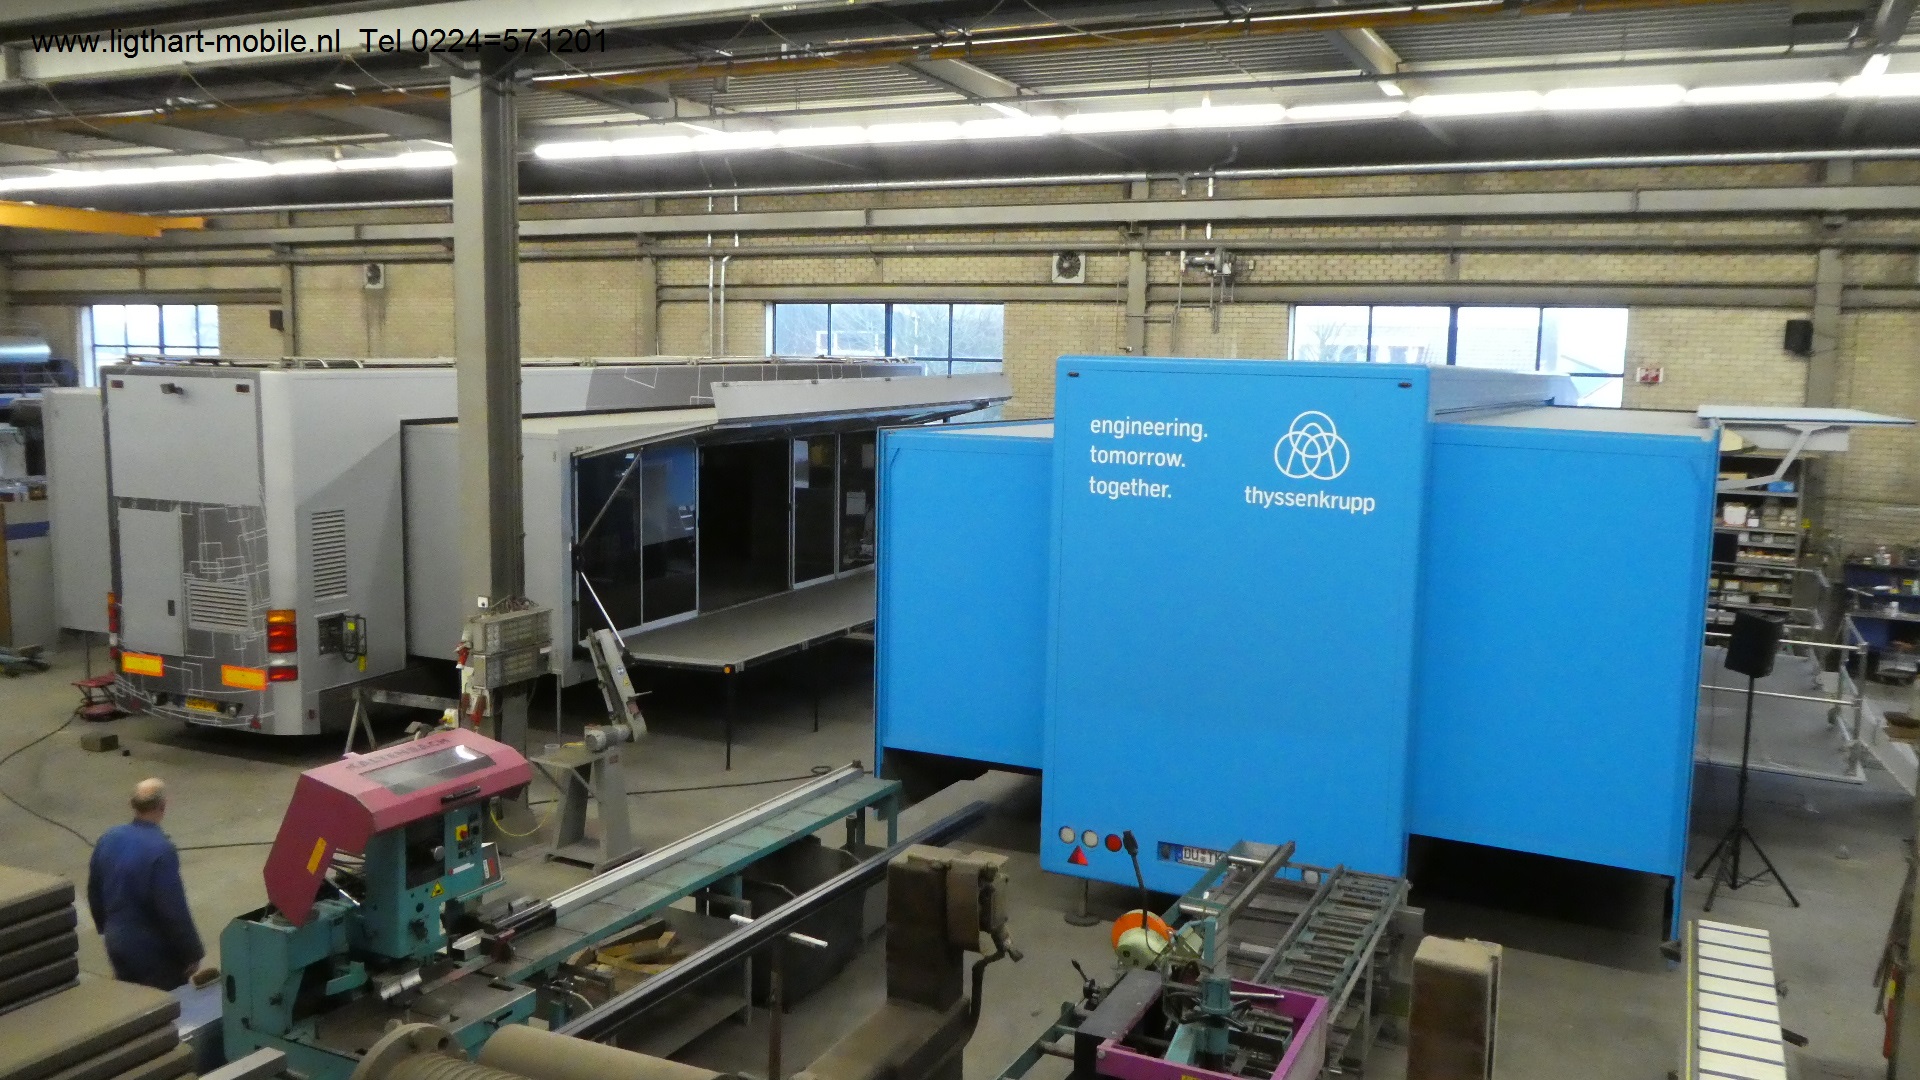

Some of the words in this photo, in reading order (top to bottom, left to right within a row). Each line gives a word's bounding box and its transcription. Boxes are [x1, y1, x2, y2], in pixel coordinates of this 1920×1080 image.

[1090, 416, 1209, 442] engineering.
[1090, 445, 1187, 468] tomorrow.
[1089, 475, 1173, 500] together.
[1244, 485, 1376, 515] thyssenkrupp
